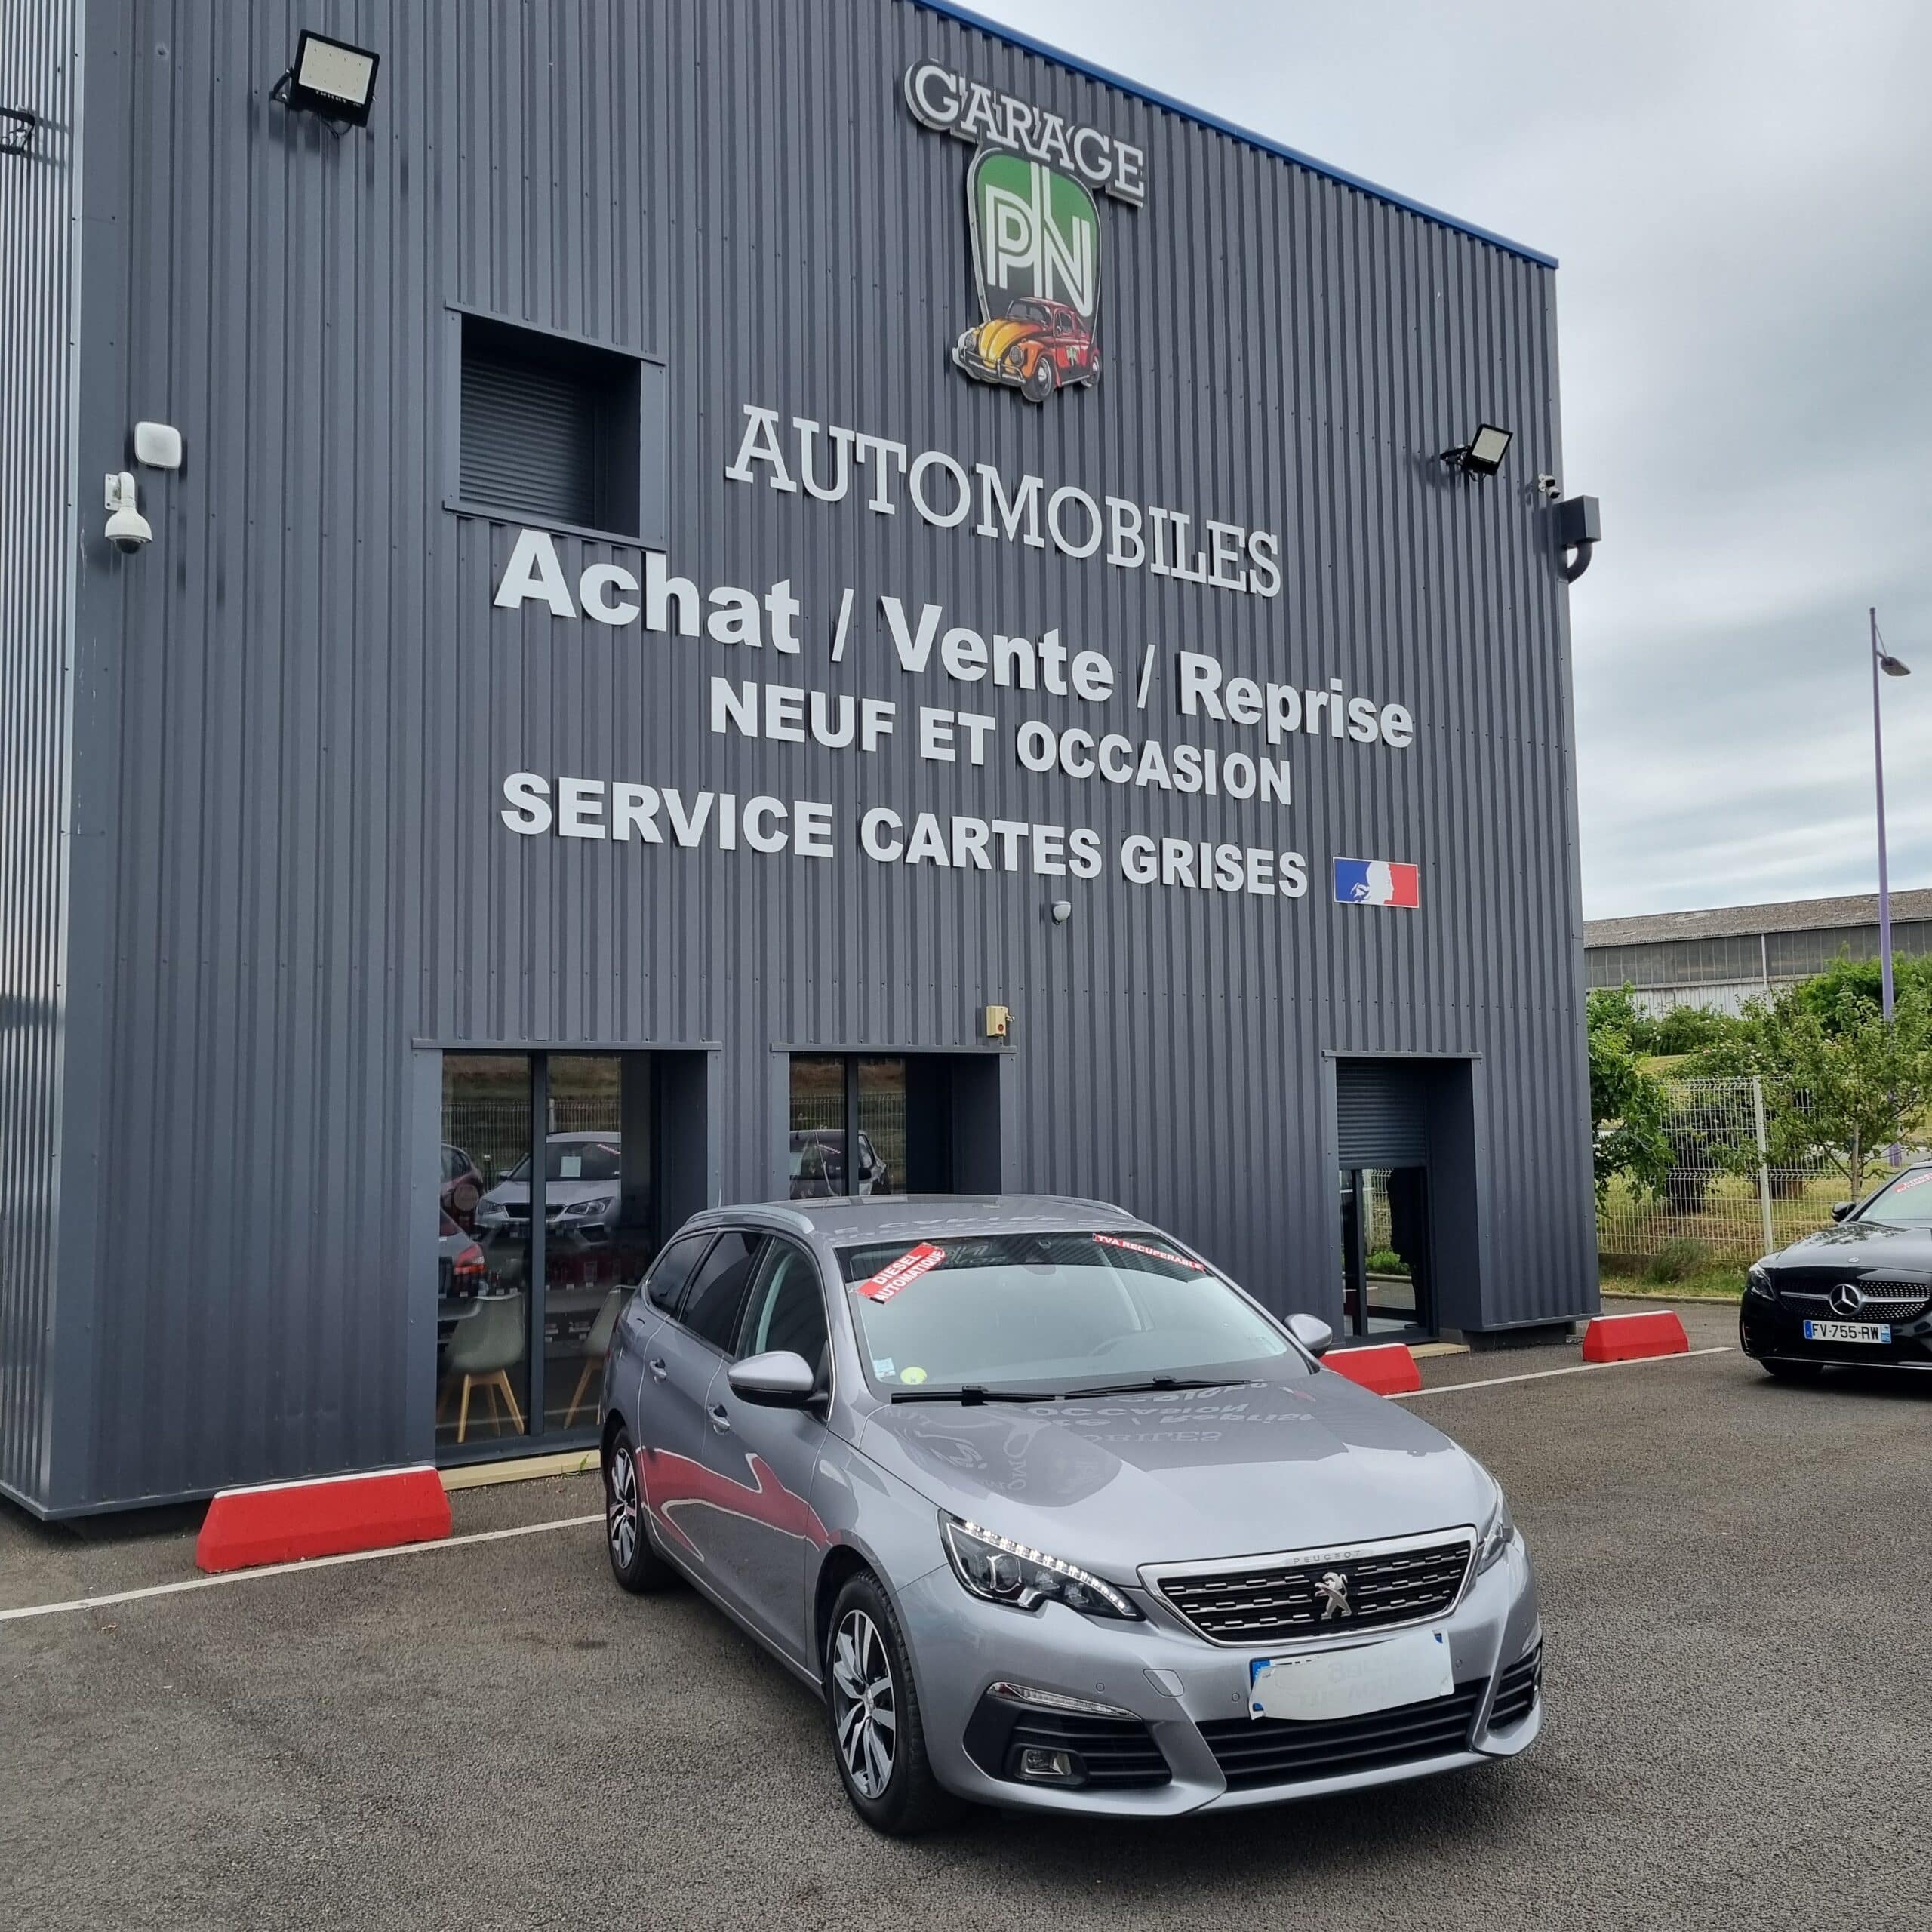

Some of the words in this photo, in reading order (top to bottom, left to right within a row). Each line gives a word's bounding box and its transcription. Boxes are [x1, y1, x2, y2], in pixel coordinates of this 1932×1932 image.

[915, 65, 1145, 198] GARAGE
[986, 161, 1092, 317] PN
[725, 404, 1281, 597] AUTOMOBILES
[494, 529, 801, 654] Achat
[831, 588, 854, 662] /
[881, 596, 1115, 702] Vente
[1137, 644, 1156, 709] /
[1180, 651, 1414, 749] Reprise
[711, 676, 896, 752] NEUF
[920, 706, 996, 765] ET
[1017, 721, 1291, 805] OCCASION
[500, 772, 834, 857] SERVICE
[860, 808, 1103, 879] CARTES
[1121, 835, 1308, 897] GRISES
[872, 1254, 922, 1285] DIESEL
[874, 1249, 944, 1300] AUTOMATIQUE
[1097, 1235, 1121, 1247] TVA
[1122, 1241, 1204, 1272] RECUPERABLE
[1812, 1323, 1879, 1340] FV-755-RW
[1293, 1550, 1361, 1564] PEUGEOT
